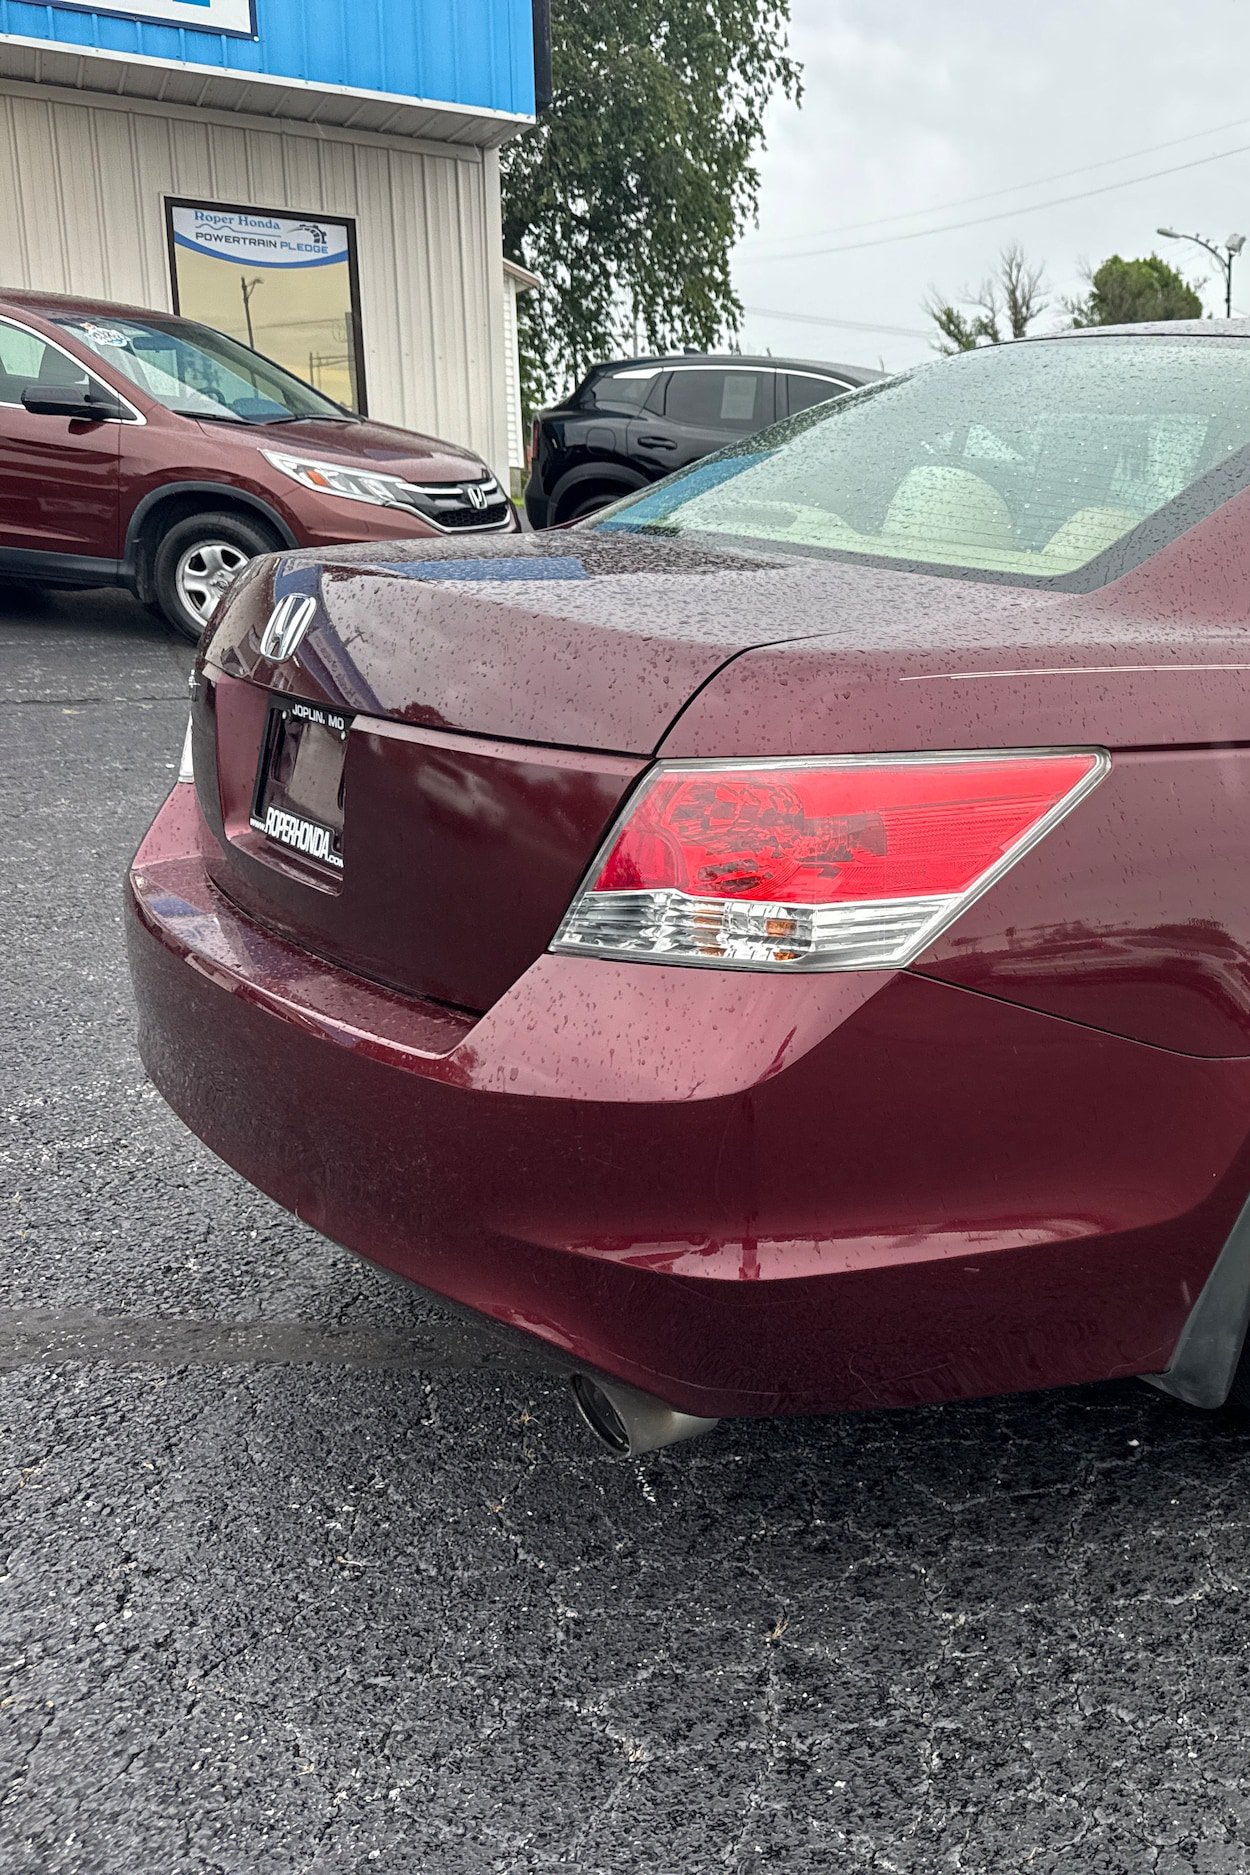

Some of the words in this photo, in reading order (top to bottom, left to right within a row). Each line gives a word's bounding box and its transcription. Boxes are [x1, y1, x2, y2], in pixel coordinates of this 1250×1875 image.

[194, 210, 234, 225] Roper
[238, 215, 281, 230] Honda
[195, 232, 277, 248] POWERTRAIN
[280, 242, 328, 254] PLEDGE
[328, 714, 345, 730] MO
